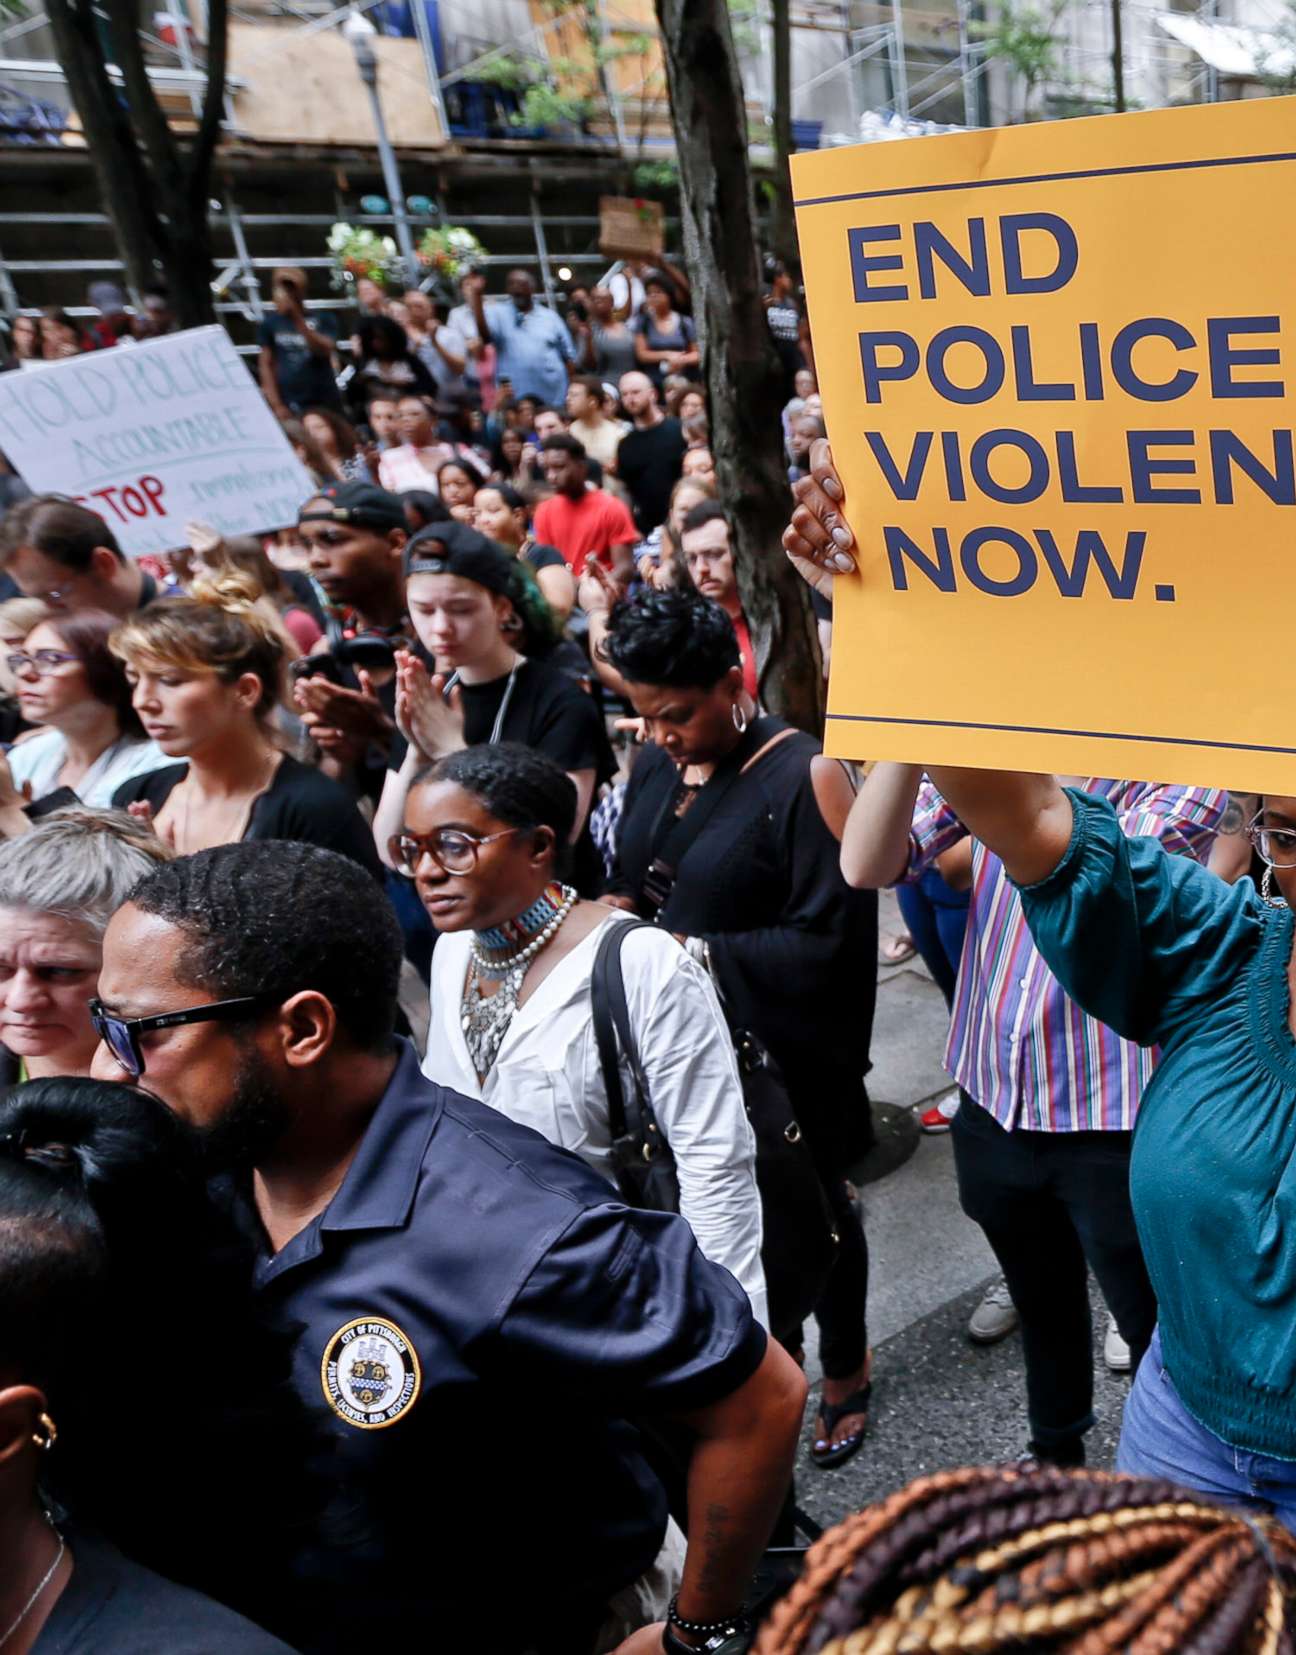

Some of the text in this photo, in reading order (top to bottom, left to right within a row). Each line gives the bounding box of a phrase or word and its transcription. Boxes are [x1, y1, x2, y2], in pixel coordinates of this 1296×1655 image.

[847, 212, 1079, 304] END
[0, 337, 255, 442] HOLD POLICE
[858, 315, 1286, 405] POLICE
[71, 405, 252, 477] ACCOUNTABLE
[882, 526, 1176, 602] NOW.
[340, 1323, 407, 1354] CITY OF PITTSBURGH
[368, 1411, 386, 1424] AND
[386, 1372, 415, 1418] INSPECTIONS
